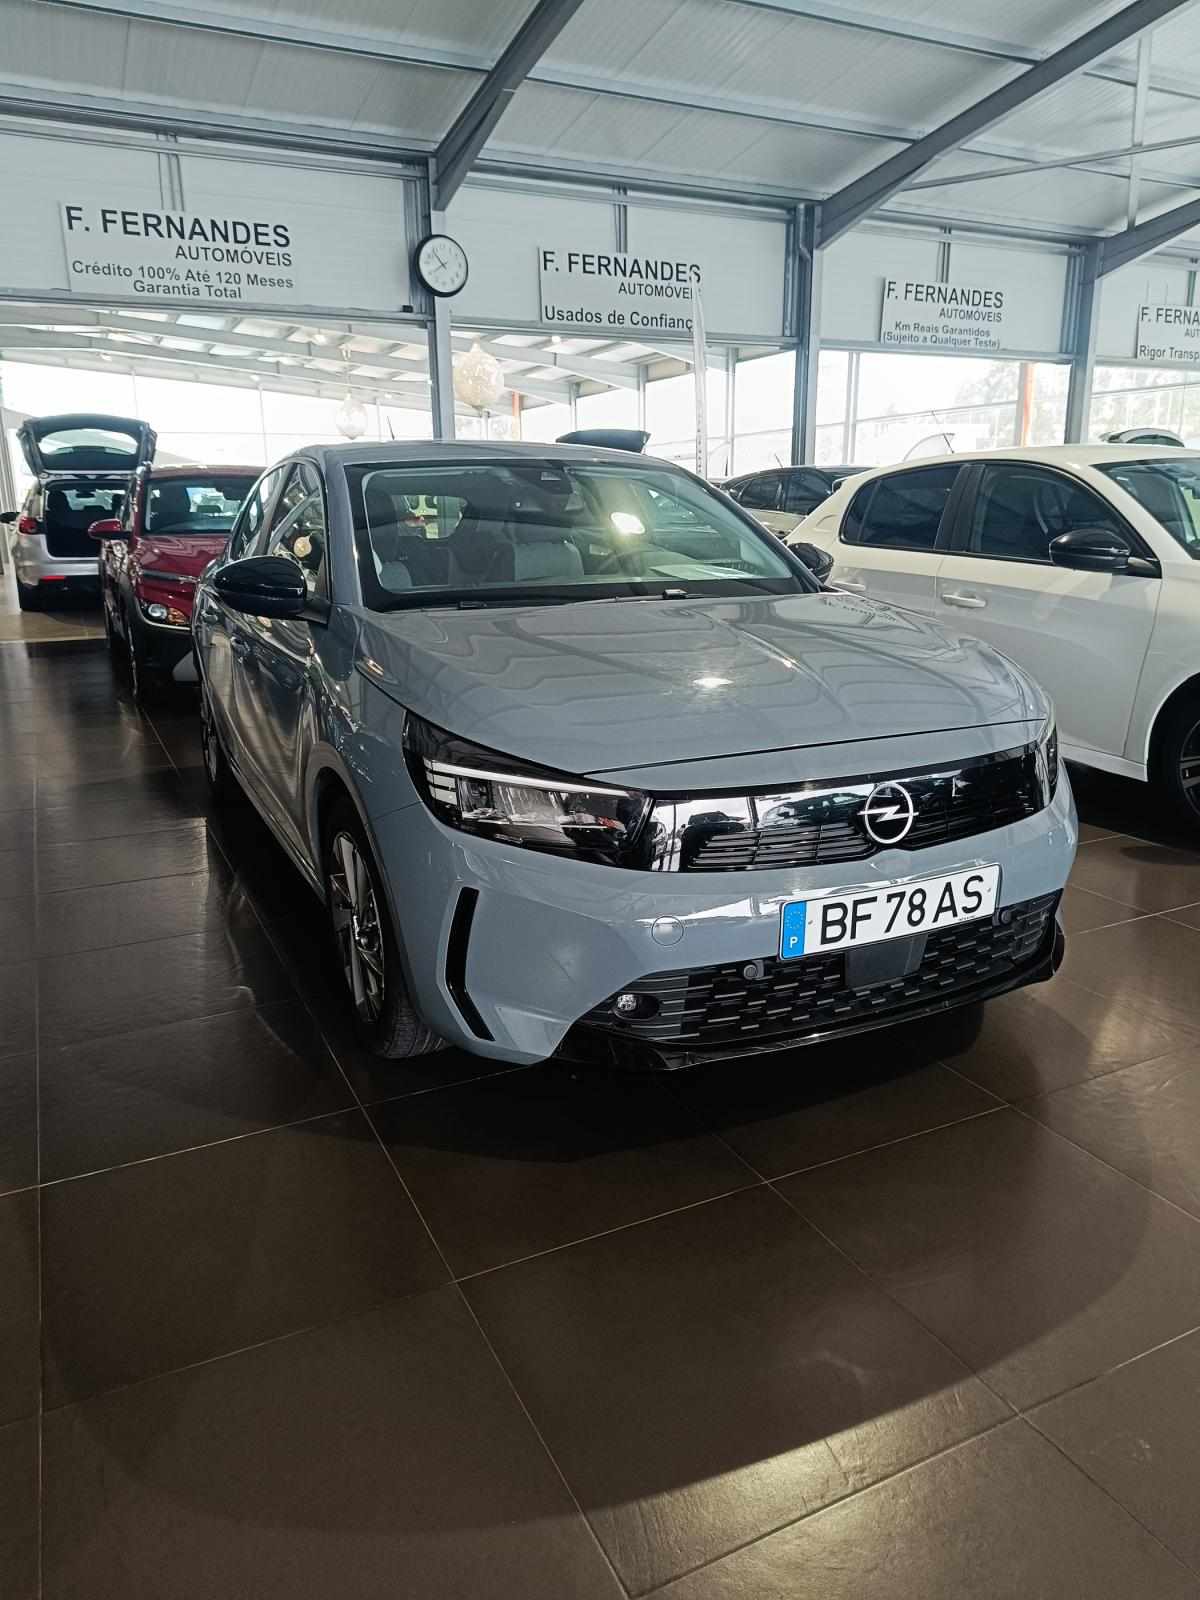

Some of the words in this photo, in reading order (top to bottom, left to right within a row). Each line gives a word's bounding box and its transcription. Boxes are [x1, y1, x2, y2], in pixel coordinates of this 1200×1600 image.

[66, 206, 90, 232] F.
[101, 209, 290, 247] FERNANDES
[175, 245, 292, 267] AUTOMÓVEIS
[72, 260, 133, 277] Crédito
[138, 265, 180, 281] 100%
[185, 268, 210, 283] Até
[216, 272, 241, 285] 120
[247, 274, 294, 288] Meses
[543, 251, 559, 272] F.
[568, 253, 701, 283] FERNANDES
[133, 280, 200, 296] Garantia
[205, 285, 242, 299] Total
[618, 282, 701, 300] AUTOMÓVEI
[887, 281, 898, 299] F.
[904, 283, 1004, 309] FERNANDES
[545, 305, 602, 324] Usados
[608, 310, 625, 325] de
[630, 312, 694, 331] Confianç
[939, 307, 1003, 323] AUTOMÓVEIS
[1141, 306, 1151, 322] F.
[895, 321, 911, 332] Km
[913, 322, 939, 334] Reais
[942, 325, 990, 337] Garantidos
[1139, 344, 1166, 360] Rigor
[820, 896, 877, 945] BF
[884, 888, 926, 933] 78
[932, 875, 984, 923] AS
[789, 936, 798, 949] P
